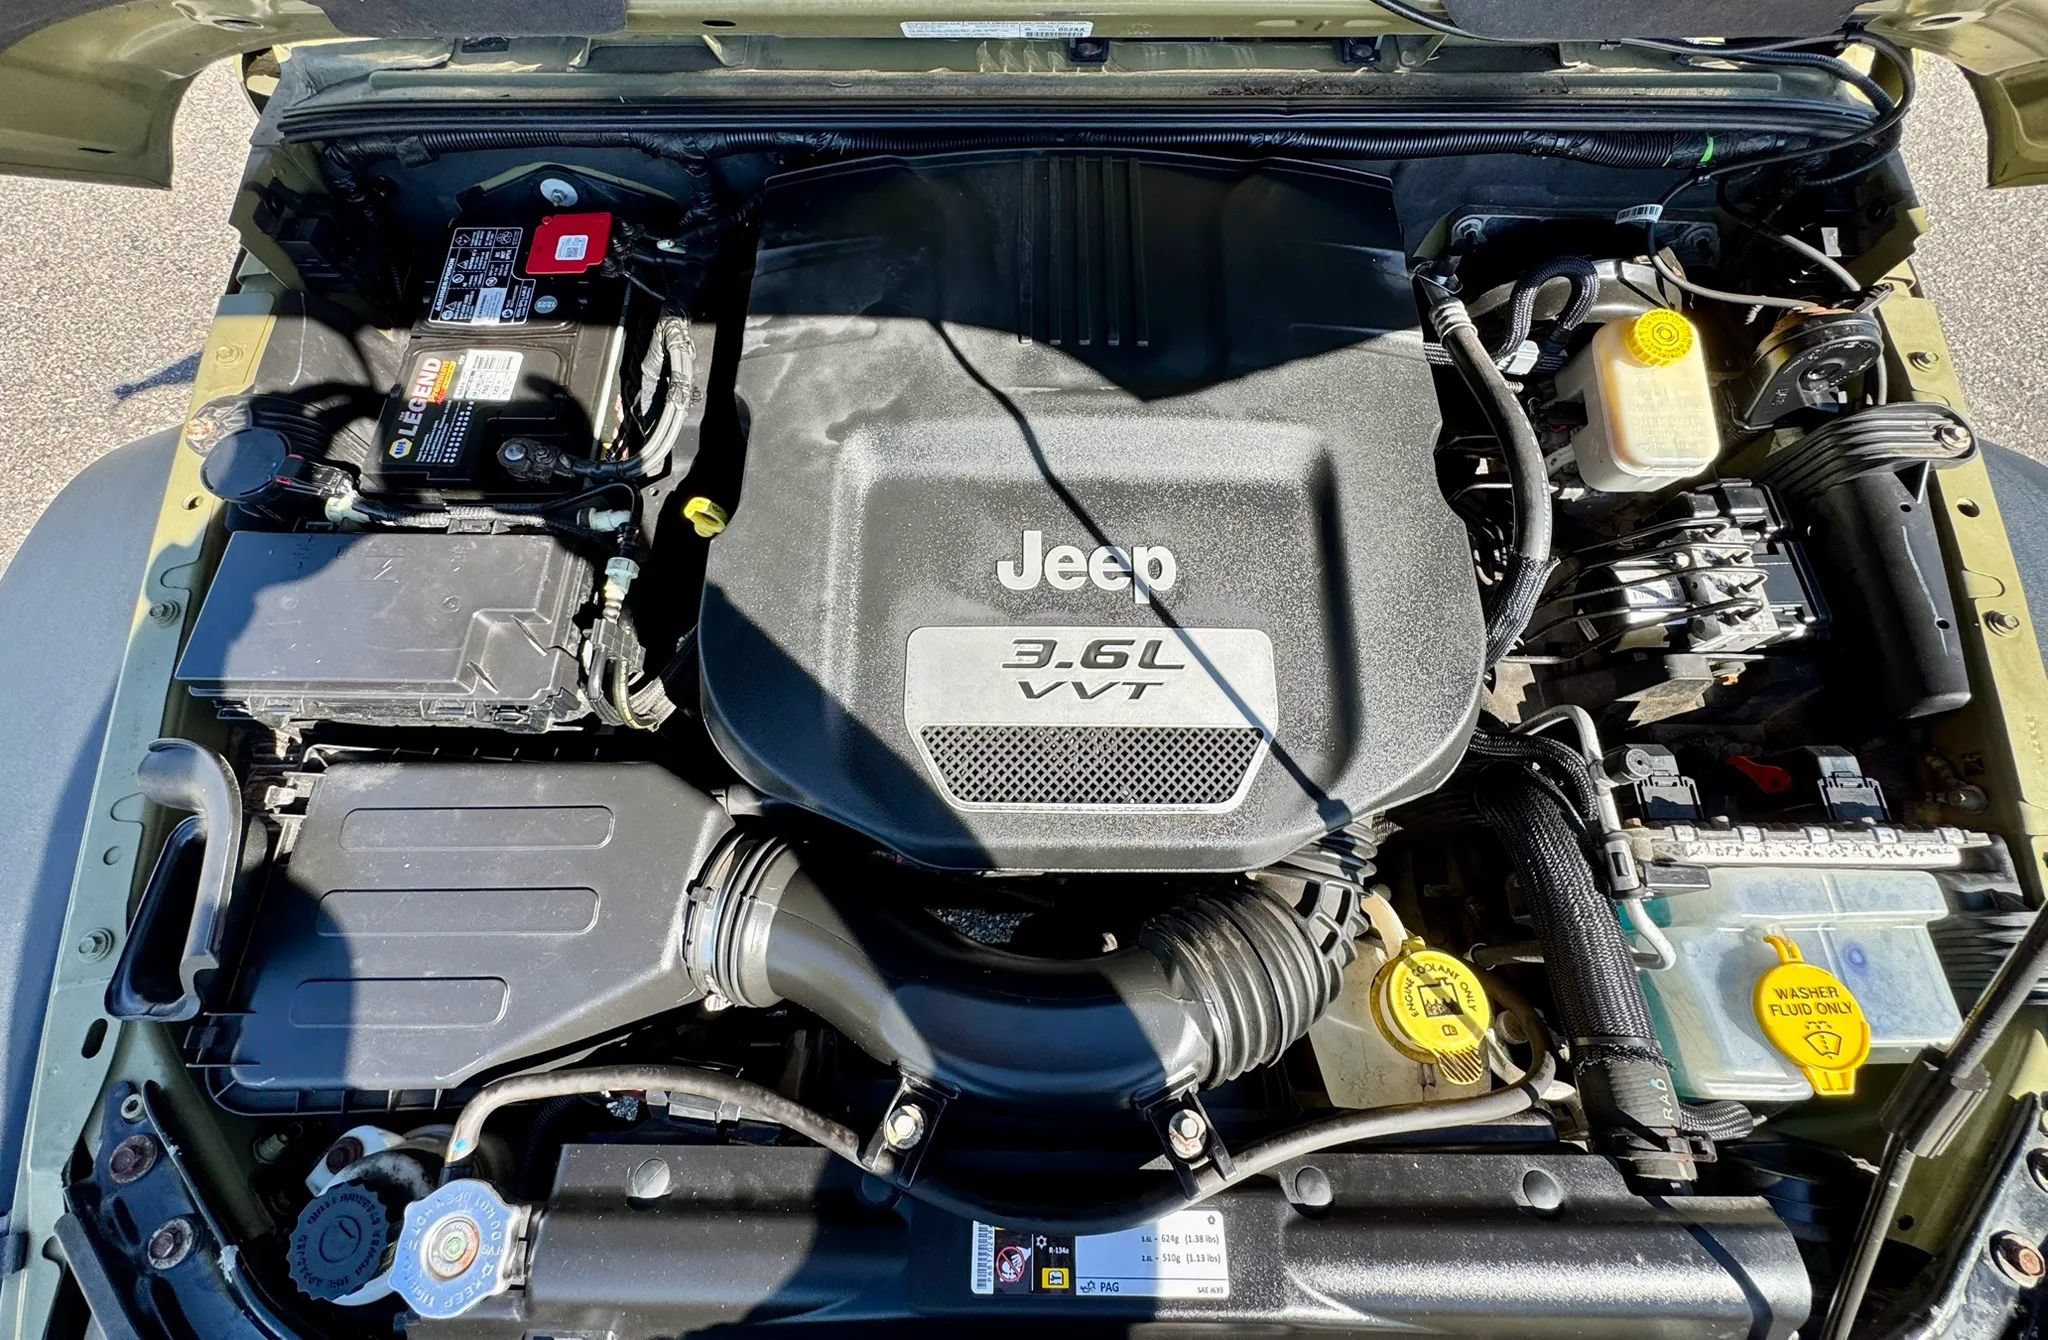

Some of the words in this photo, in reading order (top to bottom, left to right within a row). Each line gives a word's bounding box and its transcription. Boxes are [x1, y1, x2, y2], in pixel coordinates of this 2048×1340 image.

[398, 357, 442, 437] LEGEND
[996, 529, 1177, 604] Jeep
[1001, 638, 1186, 670] 3.6L
[1017, 680, 1165, 700] VVT
[1411, 963, 1460, 980] COOLANT
[1404, 976, 1420, 1018] ENGINE
[1460, 981, 1477, 1012] ONLY
[1774, 986, 1839, 1000] WASHER
[1769, 1002, 1813, 1016] FLUID
[1816, 1001, 1853, 1015] ONLY
[1161, 1234, 1180, 1245] 624g
[1185, 1234, 1204, 1245] (1.38
[1205, 1234, 1220, 1245] lbs)
[1048, 1246, 1070, 1255] R-134a
[1162, 1253, 1181, 1264] 510g
[1186, 1253, 1205, 1265] (1.13
[1206, 1253, 1222, 1265] lbs)
[444, 1279, 483, 1308] KEEP
[1100, 1281, 1119, 1293] PAG
